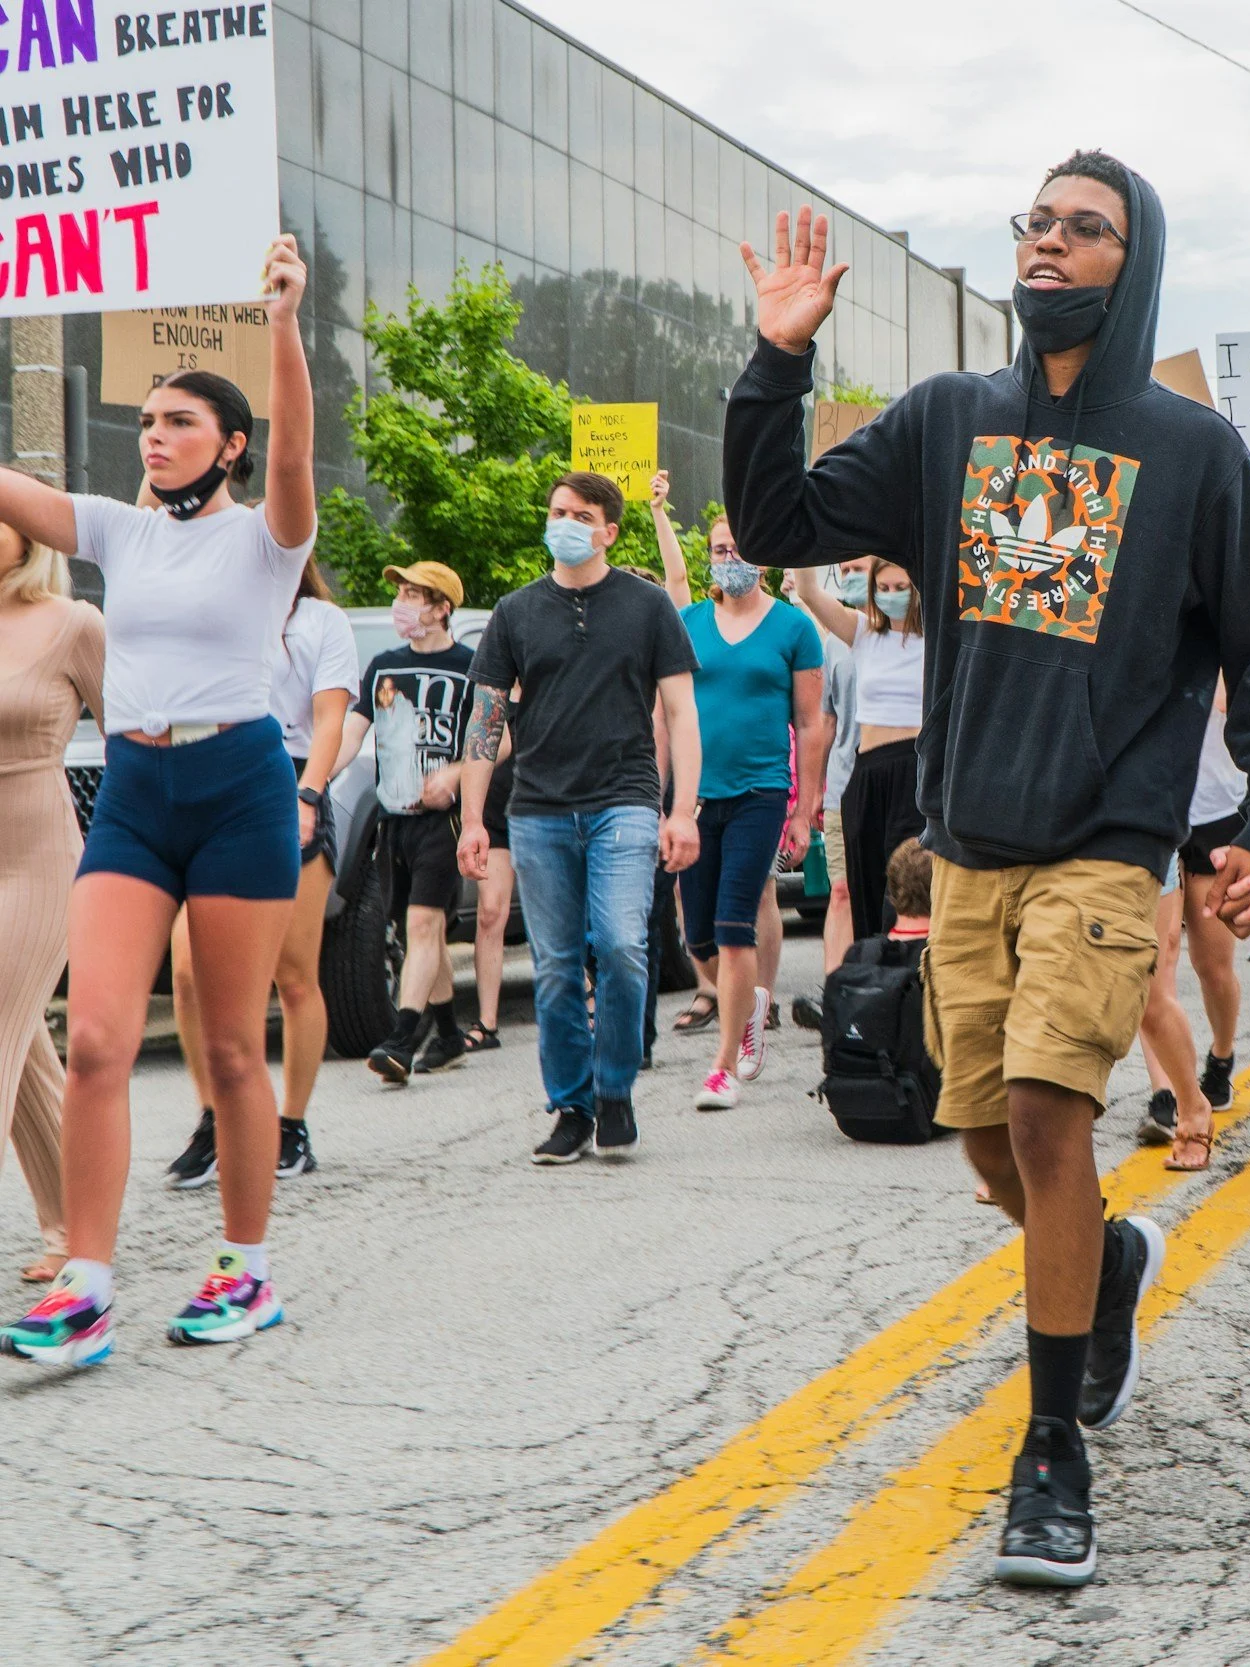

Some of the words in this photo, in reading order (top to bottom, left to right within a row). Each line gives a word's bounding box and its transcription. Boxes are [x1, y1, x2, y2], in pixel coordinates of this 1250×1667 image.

[115, 4, 267, 57] BREATHE
[62, 90, 161, 136] HERE
[176, 81, 236, 122] FOR
[110, 141, 193, 189] WHO
[152, 321, 224, 352] ENOUGH
[177, 352, 198, 370] IS
[1218, 342, 1242, 379] I
[577, 413, 592, 427] NO
[599, 413, 627, 427] MORE
[1220, 395, 1248, 429] I
[578, 445, 617, 458] White
[590, 430, 629, 442] Excuses
[989, 454, 1058, 493] BRAND
[1062, 463, 1105, 514] WITH
[971, 495, 992, 537] THE
[1085, 522, 1108, 566] THE
[1026, 569, 1093, 611] THREE
